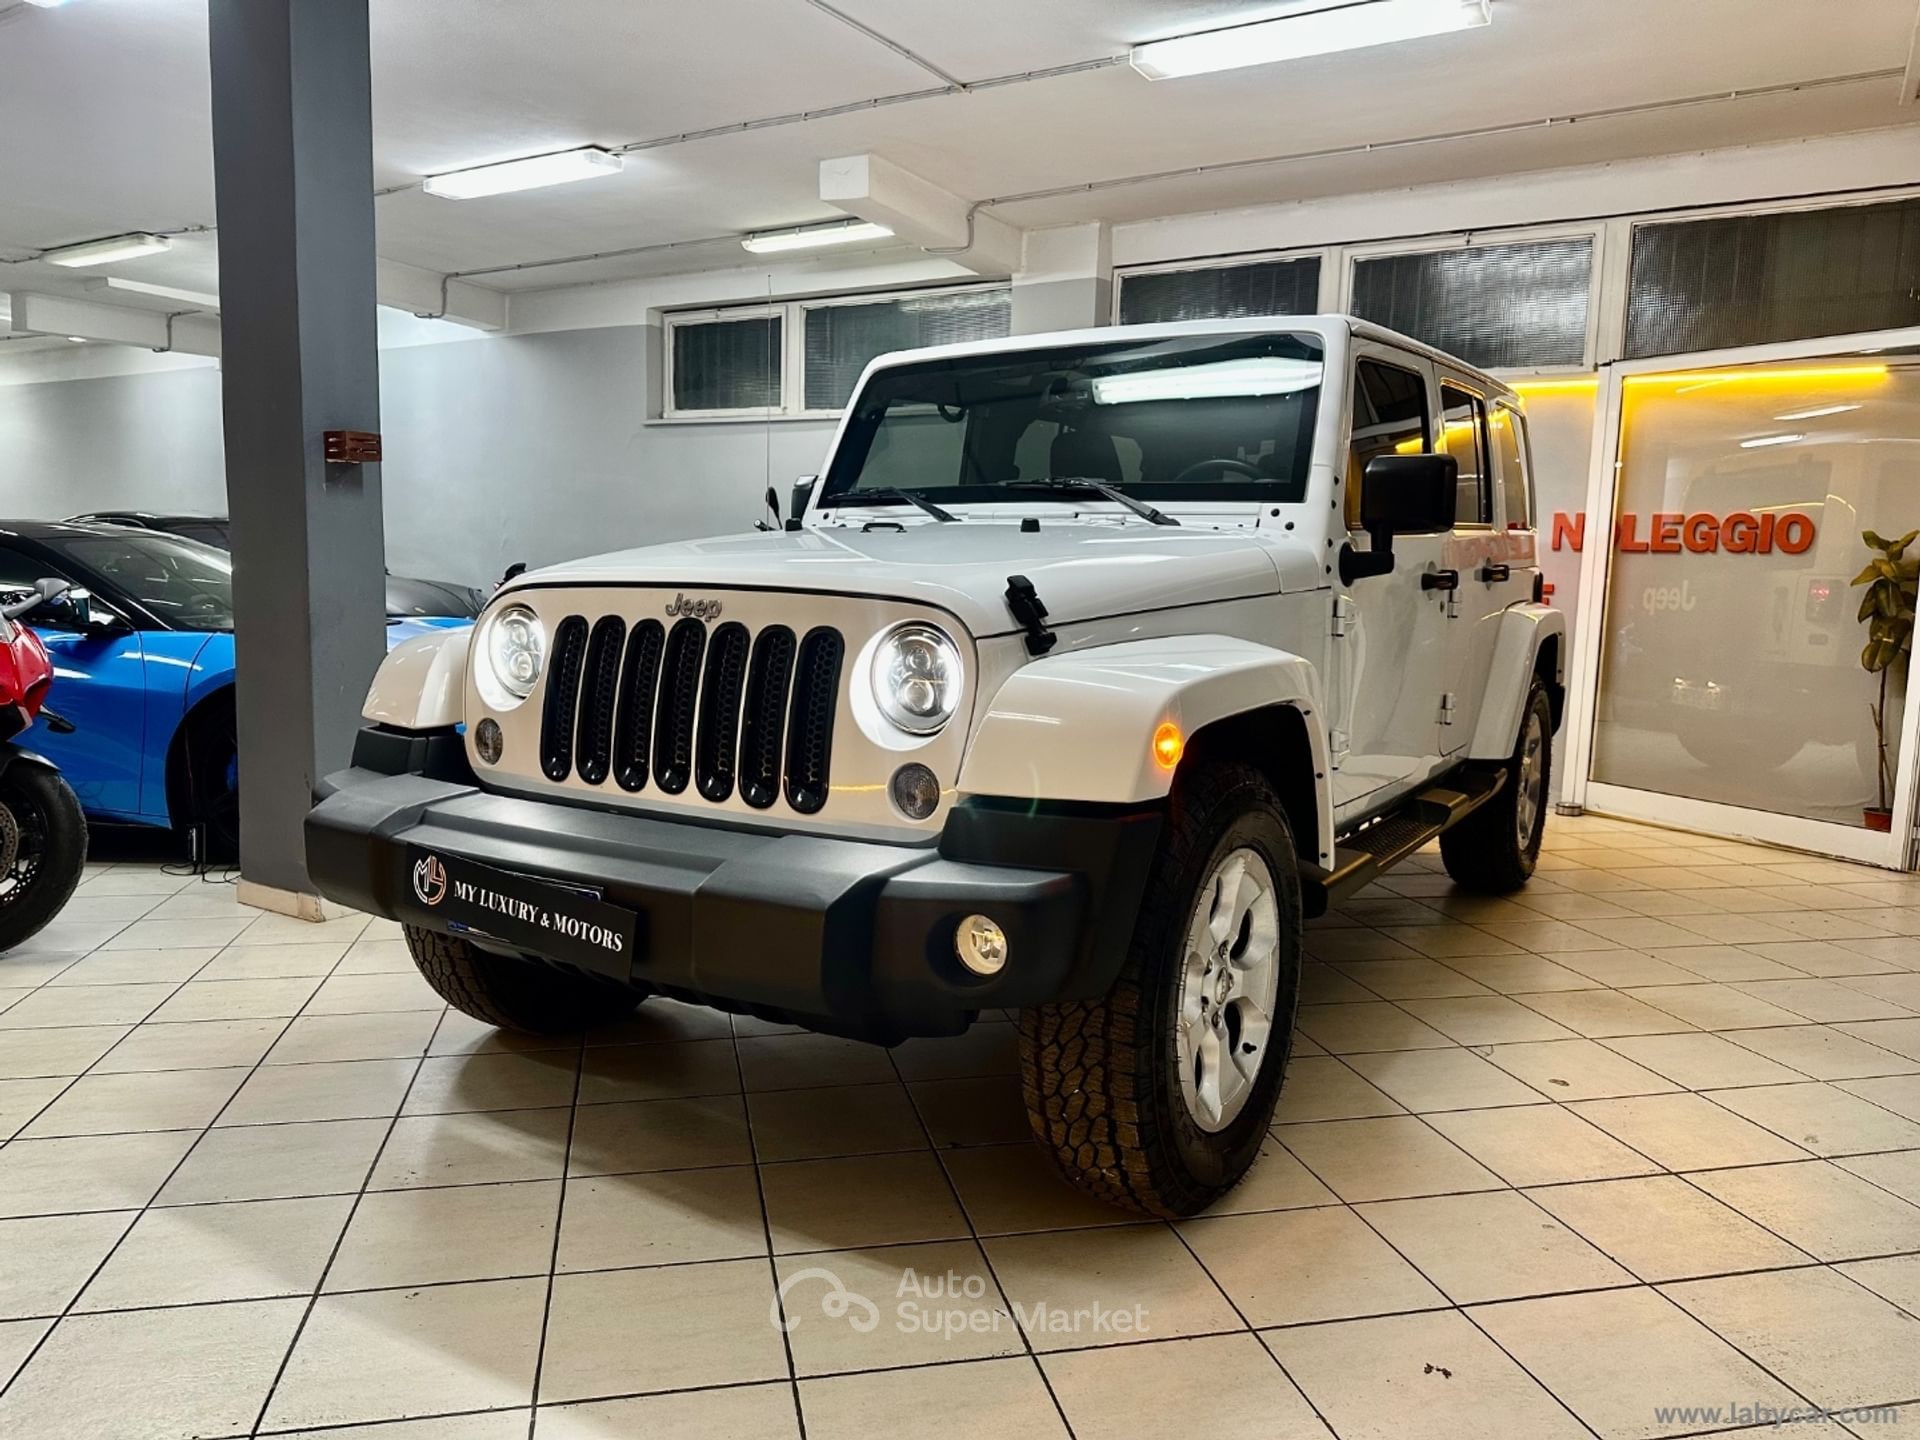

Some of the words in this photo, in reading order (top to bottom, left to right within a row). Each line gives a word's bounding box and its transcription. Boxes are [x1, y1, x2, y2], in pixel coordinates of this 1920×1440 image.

[1552, 511, 1815, 554] NLEGGIO
[665, 592, 722, 623] Jeep
[454, 880, 478, 902] MY
[479, 889, 539, 924] LUXURY
[540, 912, 550, 928] &
[553, 912, 623, 952] MOTORS
